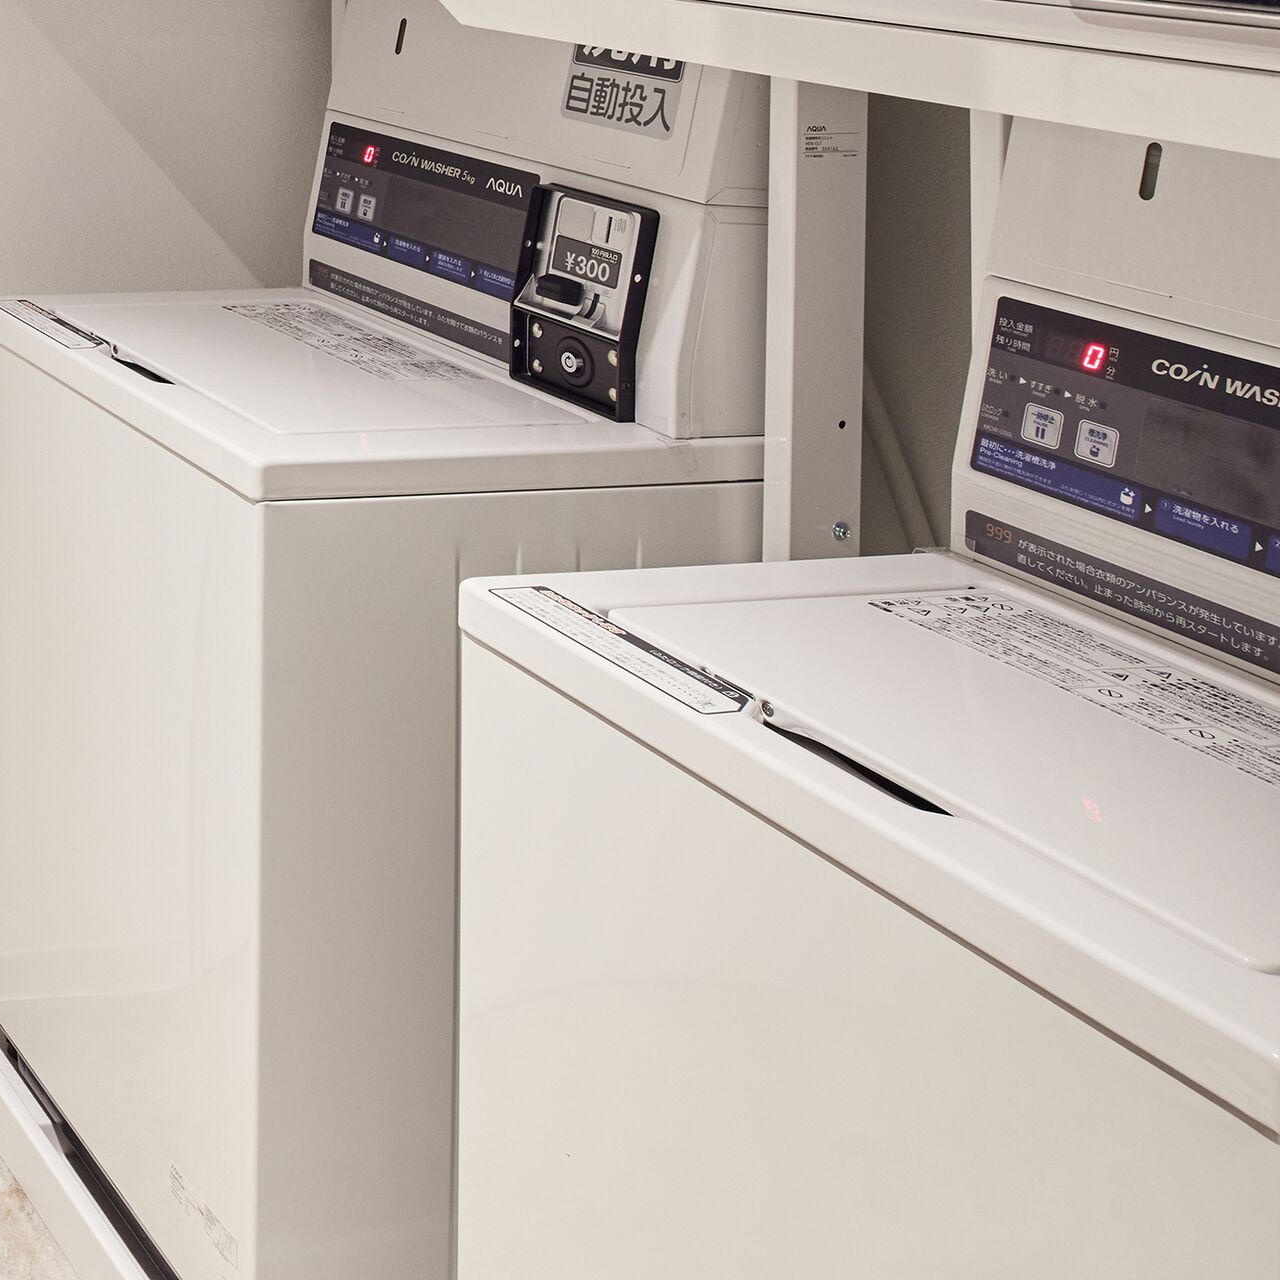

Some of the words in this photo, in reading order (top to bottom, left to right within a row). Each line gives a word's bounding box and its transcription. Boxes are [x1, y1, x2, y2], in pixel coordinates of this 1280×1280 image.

[566, 72, 670, 132] 自動投入
[363, 146, 375, 163] 0
[420, 159, 461, 179] WASHER
[486, 177, 523, 198] AQUA
[564, 251, 610, 282] ¥300
[999, 317, 1033, 334] 投入金額
[995, 334, 1031, 352] 残り時間
[1109, 346, 1120, 358] 円
[1082, 344, 1104, 370] 0
[1106, 365, 1116, 376] 分
[1029, 379, 1053, 394] すすぎ
[1075, 393, 1098, 408] 脱水
[979, 446, 1023, 468] Pre-Cleaning
[1172, 503, 1240, 535] 洗濯物を入れる
[985, 523, 1013, 545] 999
